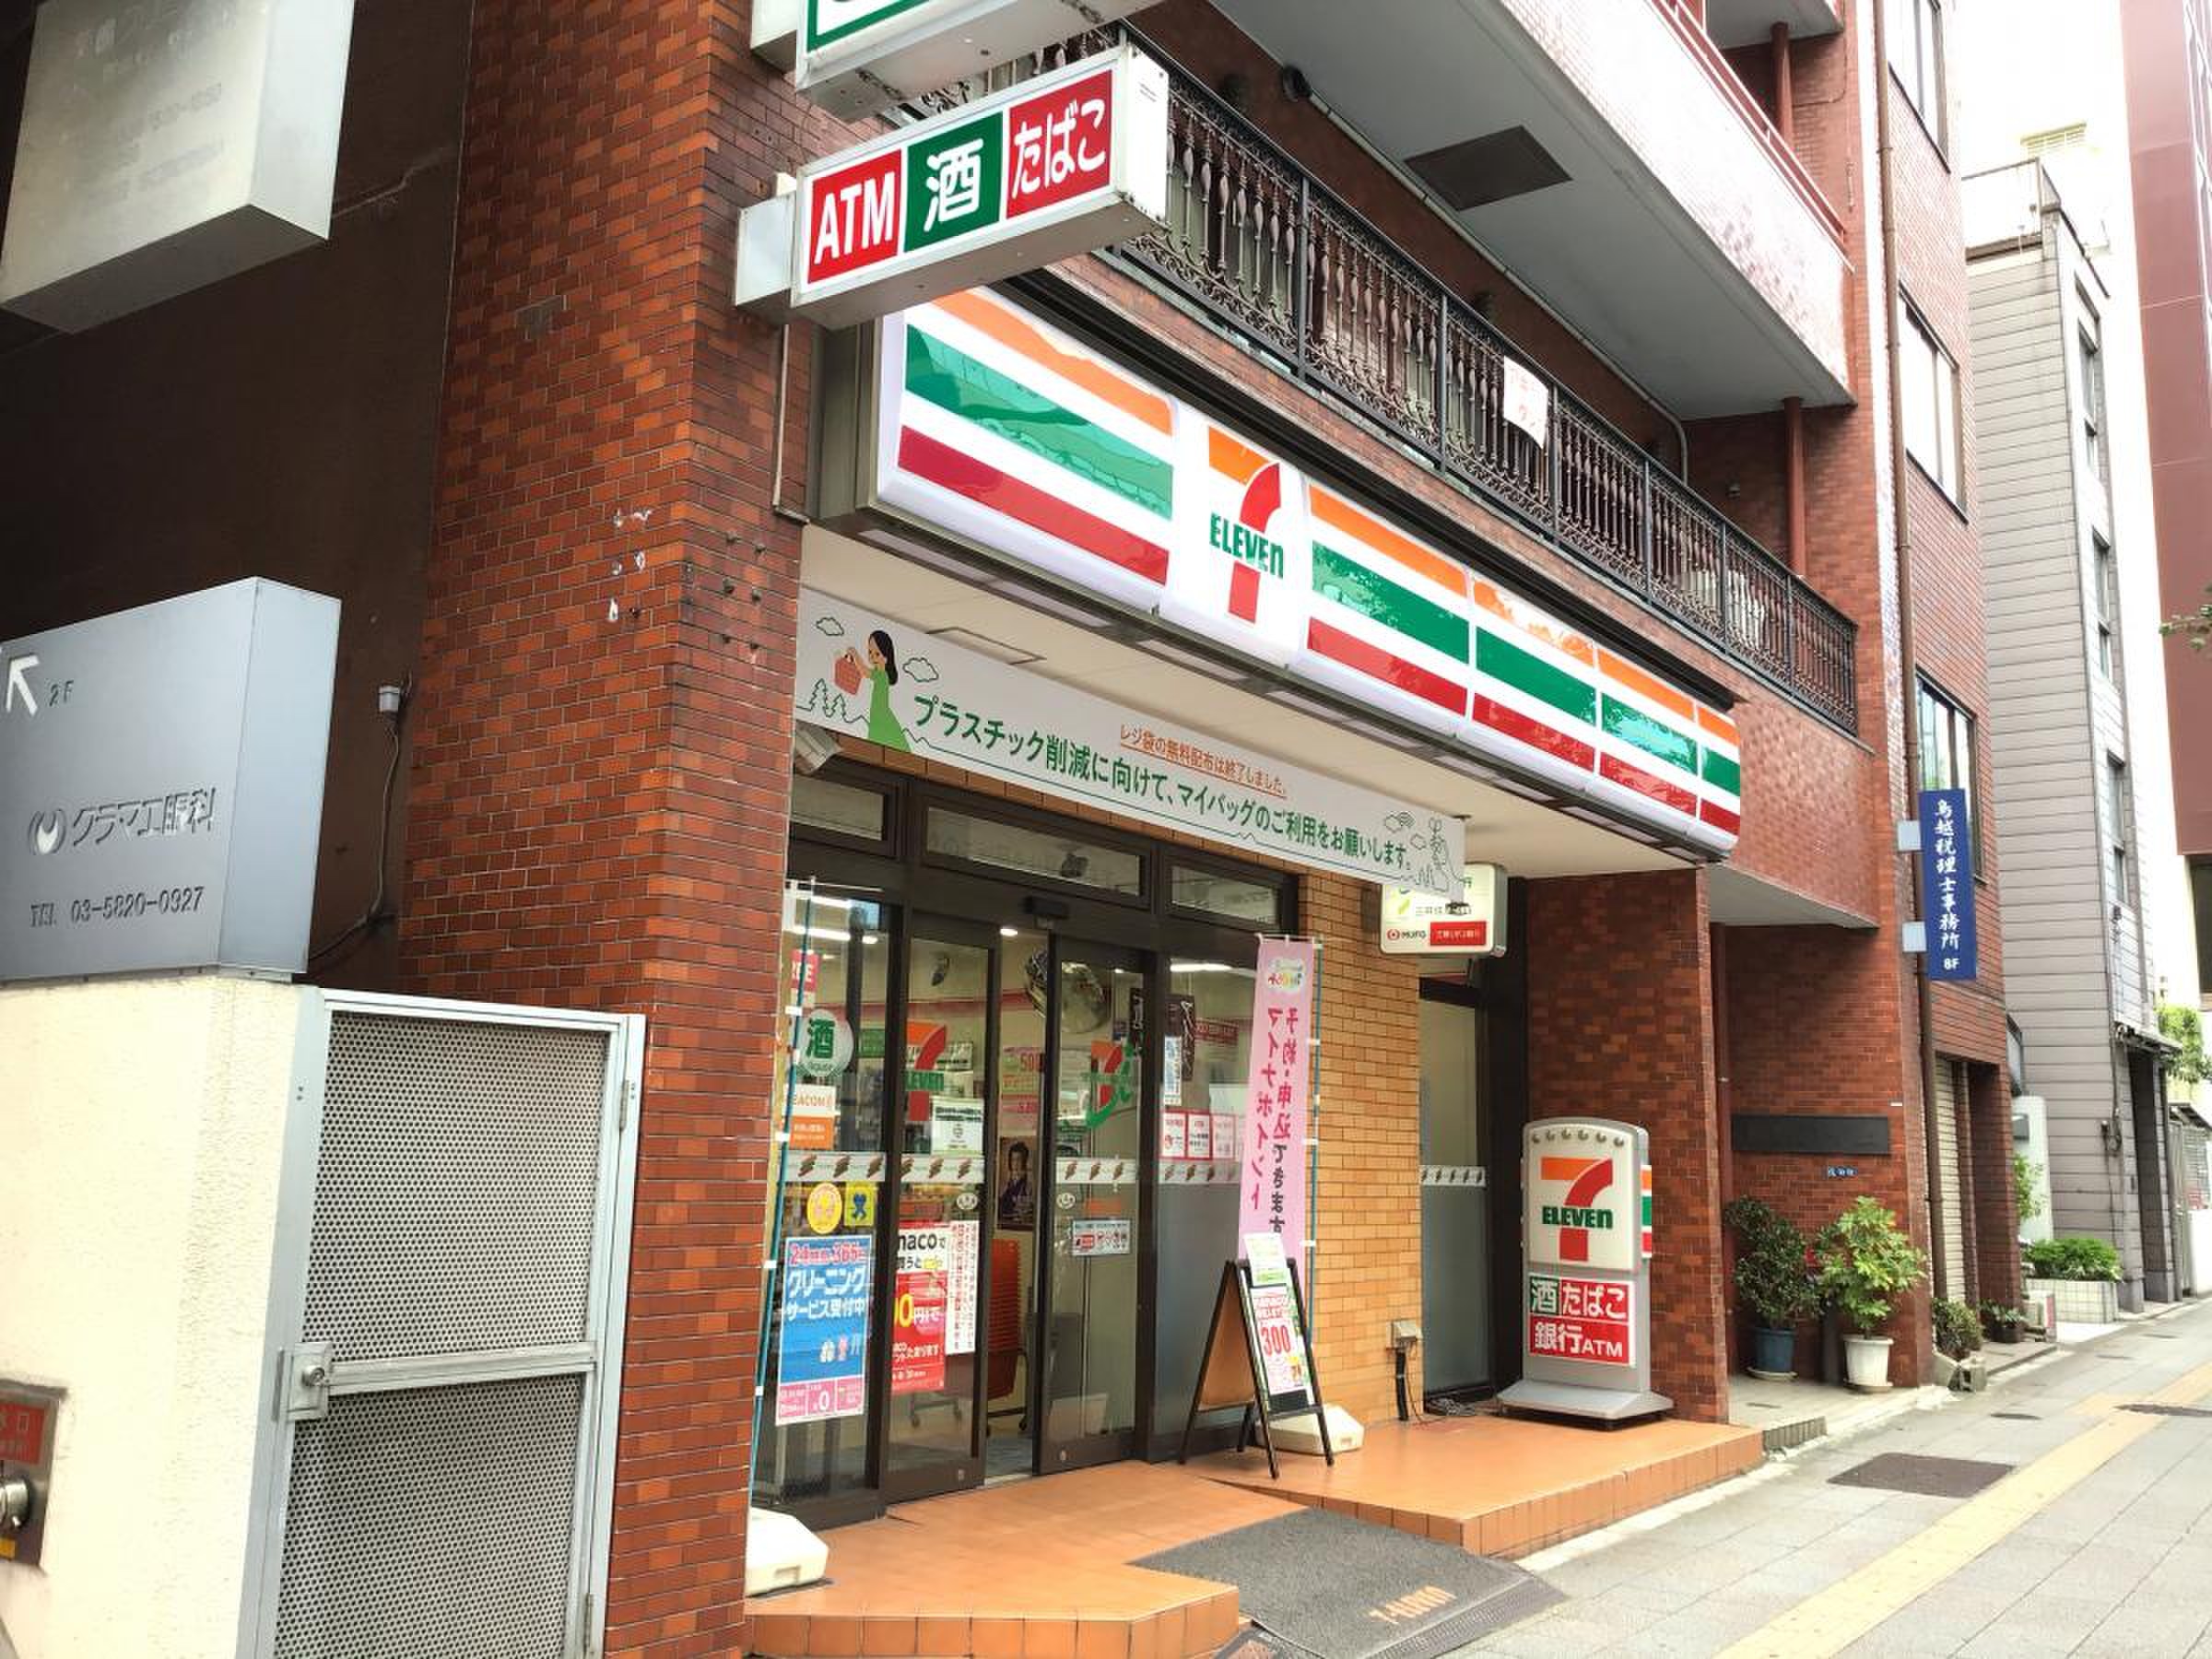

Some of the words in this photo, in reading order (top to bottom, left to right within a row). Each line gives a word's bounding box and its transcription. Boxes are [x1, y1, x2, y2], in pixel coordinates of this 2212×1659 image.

[1011, 98, 1107, 199] たばこ
[924, 137, 983, 232] 酒
[814, 171, 895, 265] ATM
[1208, 426, 1282, 625] 7
[47, 678, 76, 707] 2F
[913, 693, 1412, 872] プラスチック削減に向けて、マイバッグのご利用をお願いします。
[73, 787, 217, 847] クラマエ眼科
[806, 1018, 836, 1059] 酒
[1540, 1157, 1614, 1262] 7
[788, 1265, 866, 1298] クリーニング
[1531, 1279, 1558, 1315] 酒
[1562, 1280, 1627, 1319] たばこ
[1260, 1324, 1291, 1357] 300
[1535, 1319, 1623, 1358] 銀行ATM
